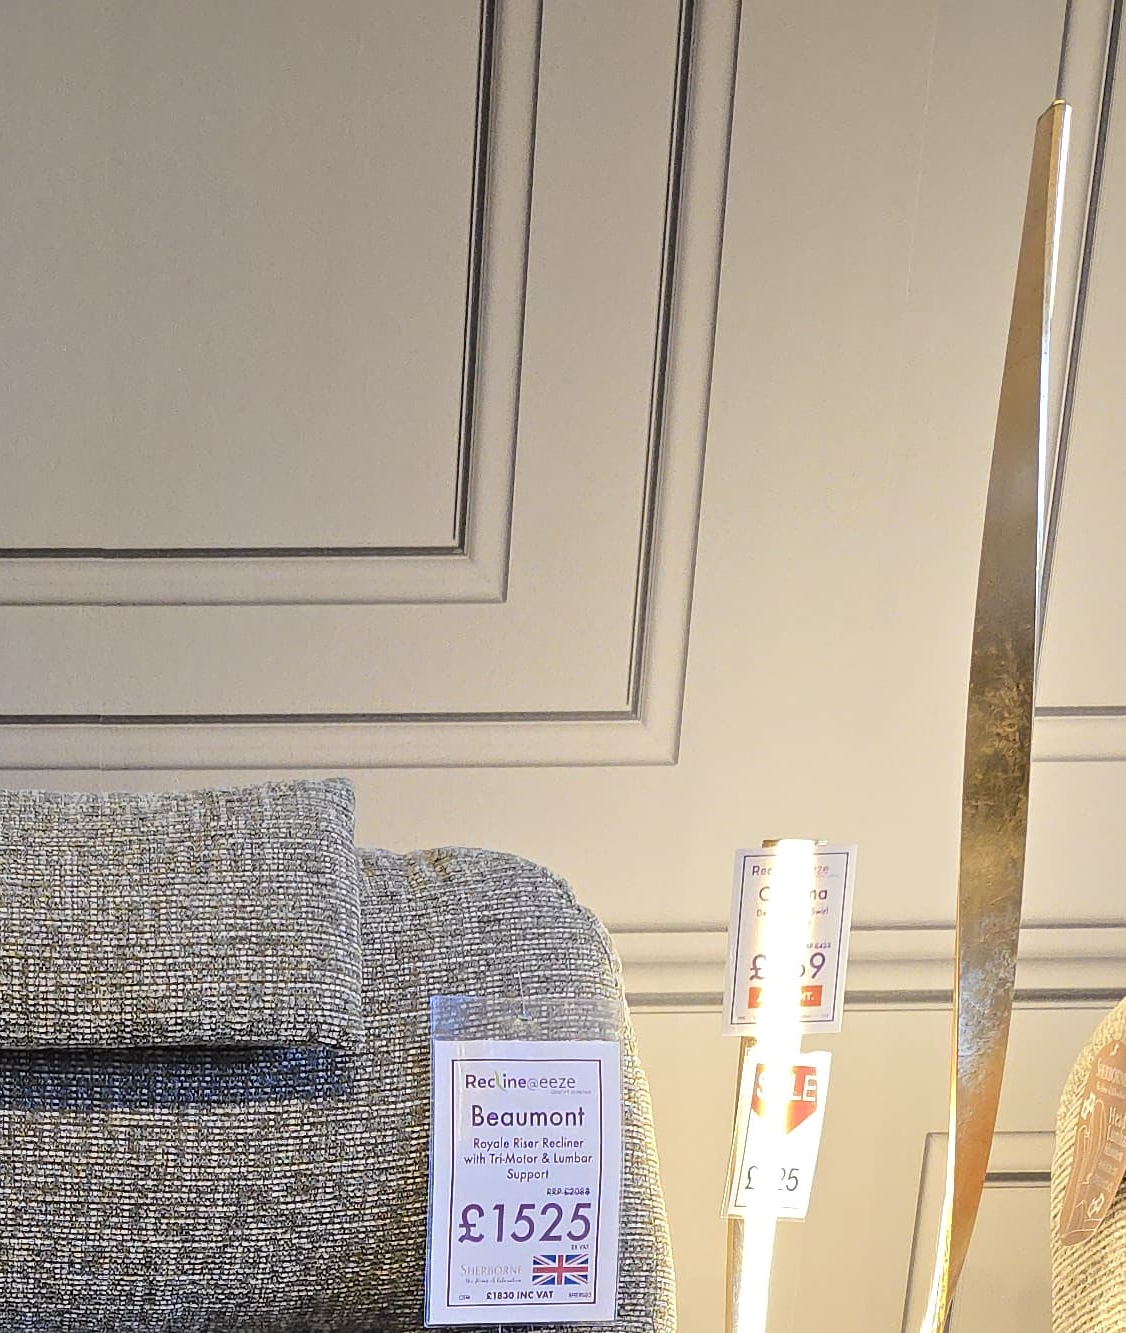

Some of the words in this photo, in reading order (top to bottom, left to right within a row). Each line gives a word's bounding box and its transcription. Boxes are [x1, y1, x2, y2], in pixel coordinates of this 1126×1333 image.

[465, 1072, 576, 1092] Recline@eeze
[471, 1105, 585, 1127] Beaumont
[473, 1137, 510, 1152] Royale
[513, 1137, 539, 1149] Riser
[542, 1136, 584, 1149] Recliner
[464, 1153, 486, 1165] with
[489, 1153, 539, 1165] Tri-Motor
[541, 1153, 550, 1164] &
[553, 1152, 593, 1164] Lumbar
[506, 1168, 549, 1183] Support
[458, 1202, 592, 1243] £1525
[486, 1291, 515, 1300] £1830
[516, 1291, 534, 1299] INC
[536, 1290, 554, 1299] VAT
